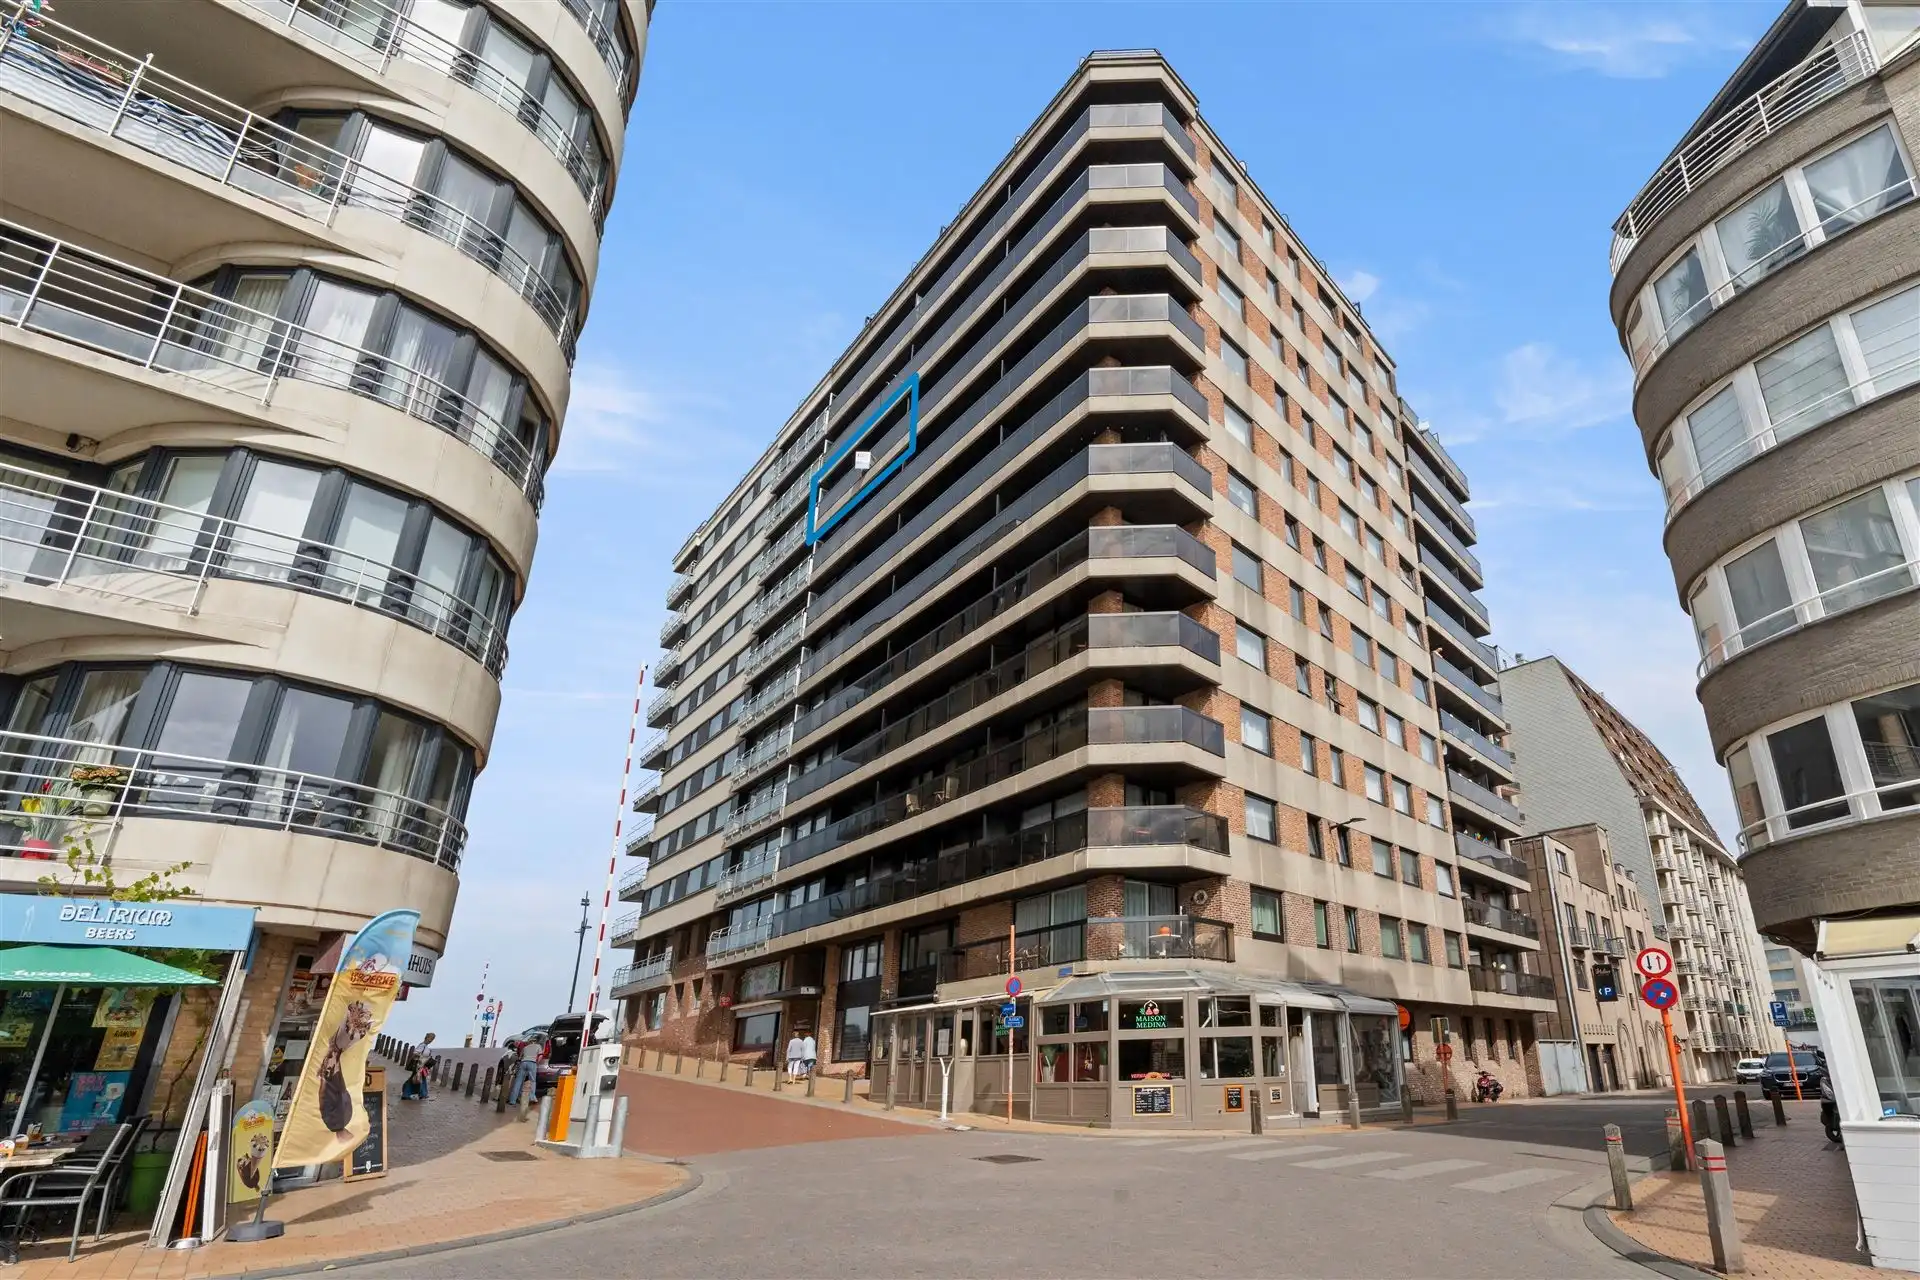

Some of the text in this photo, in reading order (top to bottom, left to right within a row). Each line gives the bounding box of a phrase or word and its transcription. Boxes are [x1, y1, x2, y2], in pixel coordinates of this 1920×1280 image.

[59, 904, 173, 927] DELIRIUM
[85, 927, 136, 940] BEERS
[1773, 1003, 1782, 1013] P
